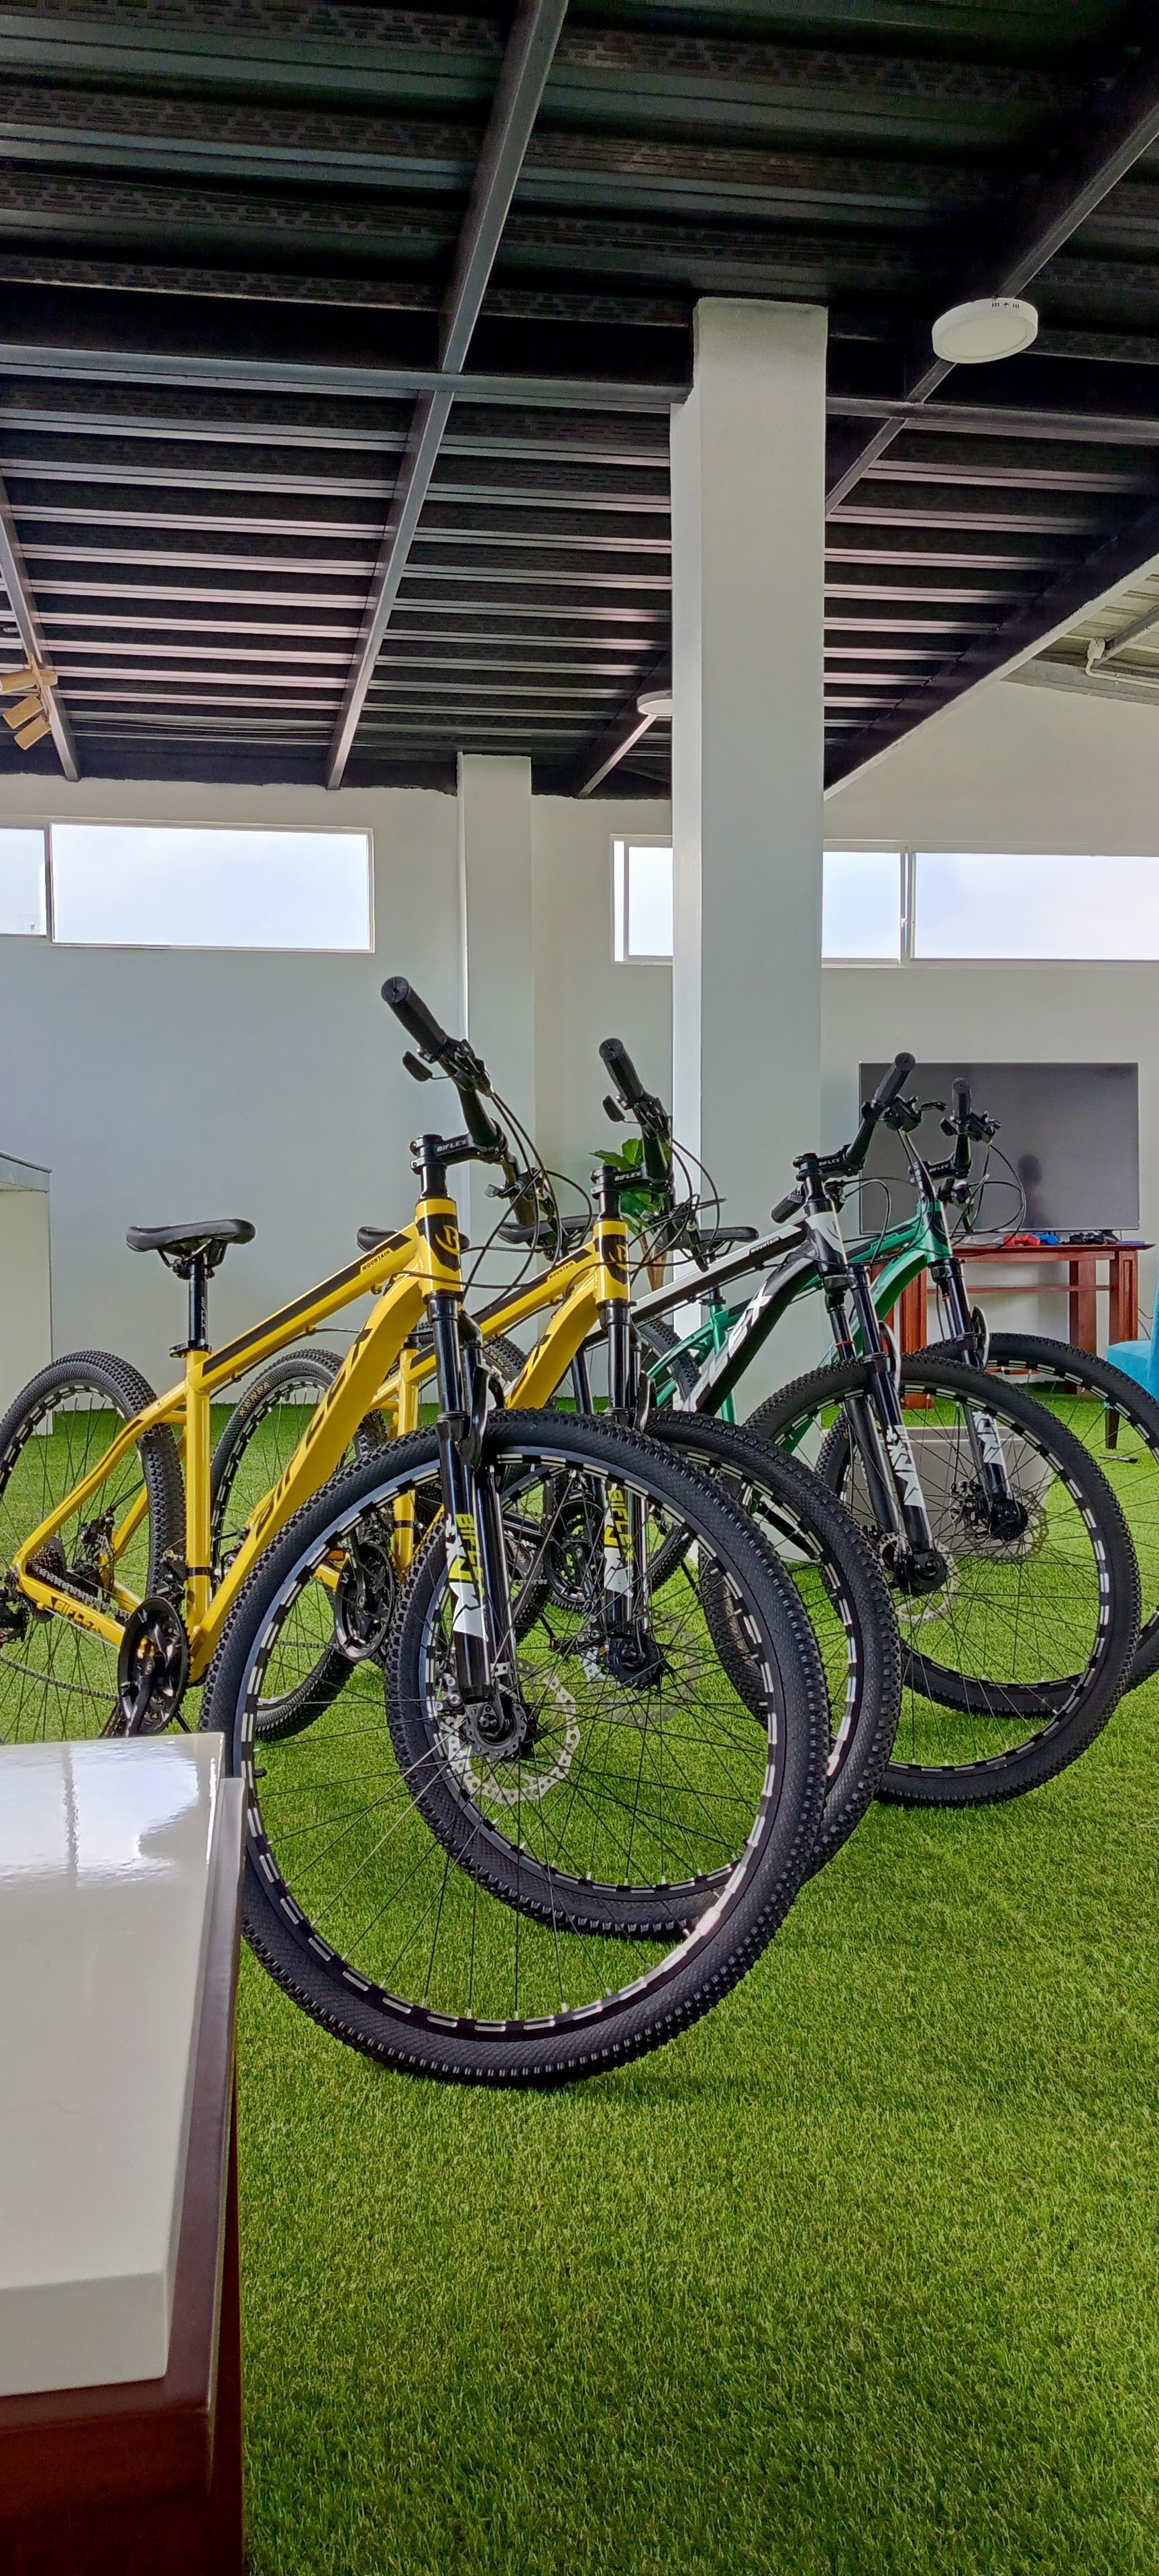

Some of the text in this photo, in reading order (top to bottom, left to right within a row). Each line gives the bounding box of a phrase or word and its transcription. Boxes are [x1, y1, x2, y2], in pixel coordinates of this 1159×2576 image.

[437, 1139, 467, 1152] BIFLEX
[362, 1250, 390, 1271] MOUNTAIN
[549, 1262, 573, 1279] MOUNTAIN
